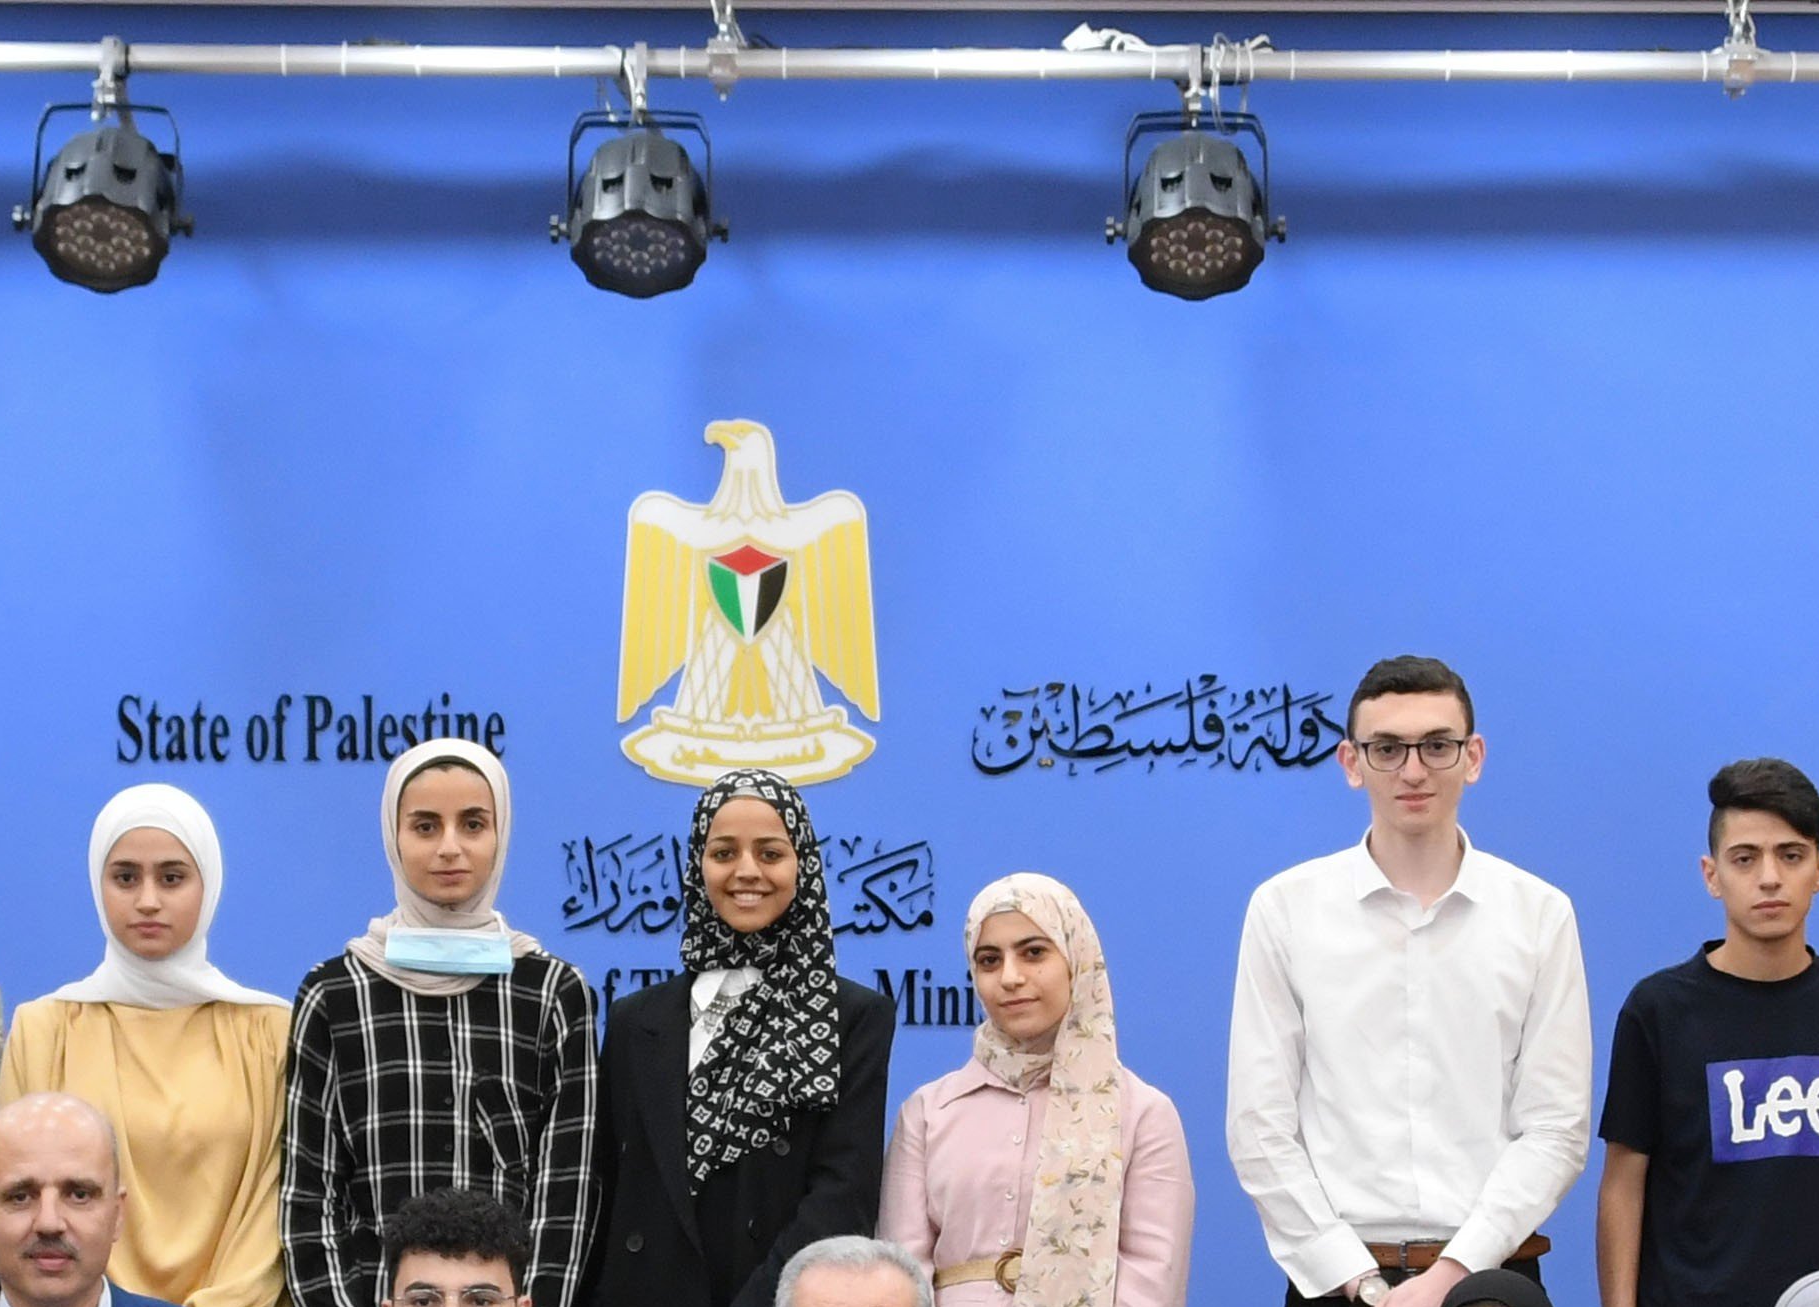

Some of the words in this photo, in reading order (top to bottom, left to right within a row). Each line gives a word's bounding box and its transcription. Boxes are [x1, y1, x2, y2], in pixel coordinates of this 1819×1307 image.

[117, 693, 231, 763] State
[246, 693, 292, 763] of
[303, 691, 506, 763] Palestine
[972, 674, 1227, 776] فلسطين
[873, 968, 984, 1027] Mini
